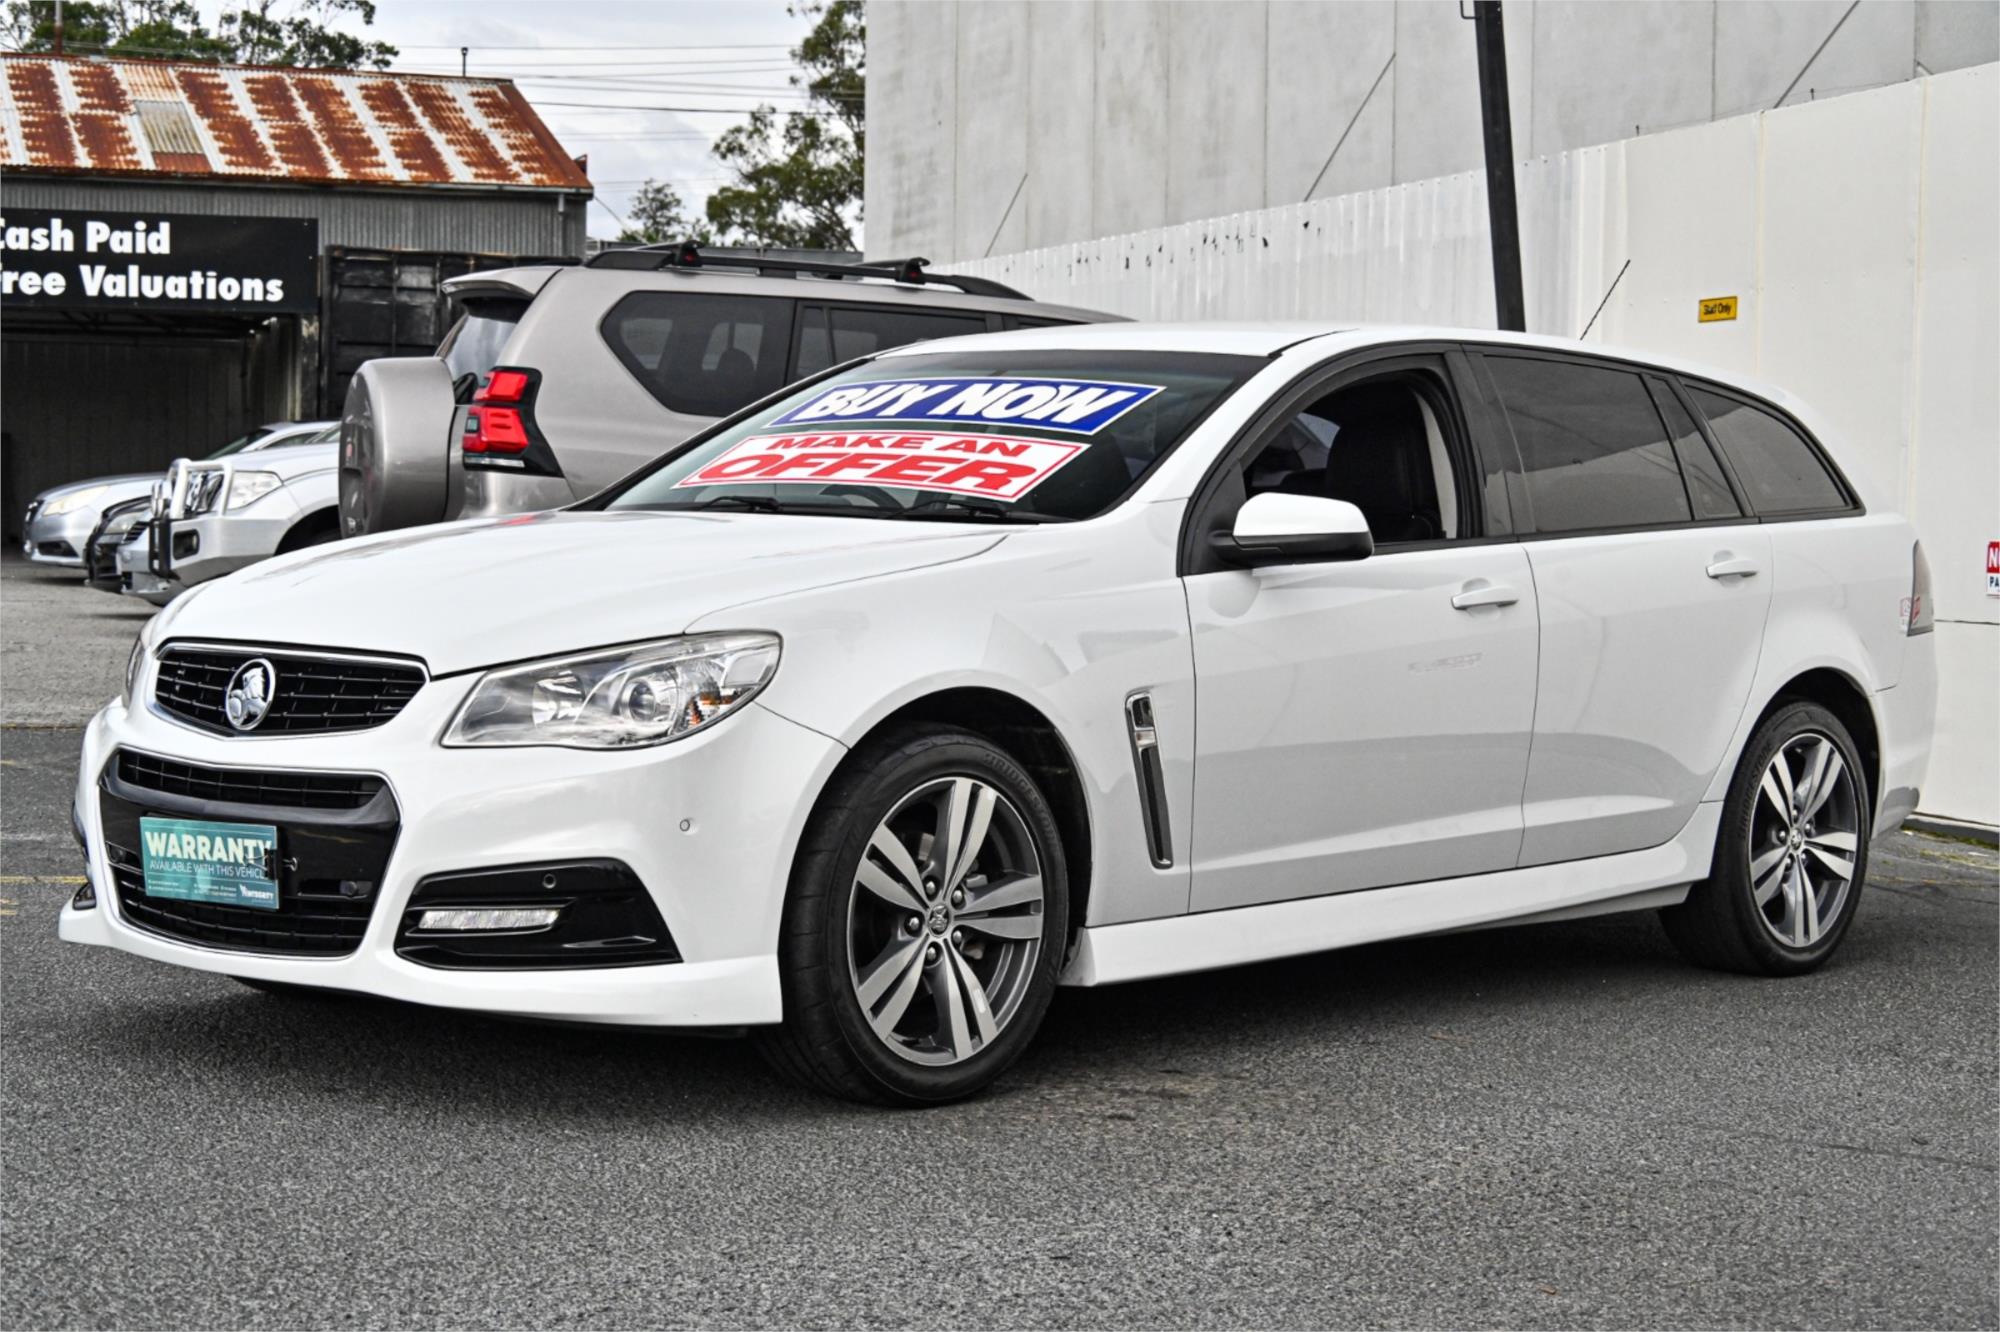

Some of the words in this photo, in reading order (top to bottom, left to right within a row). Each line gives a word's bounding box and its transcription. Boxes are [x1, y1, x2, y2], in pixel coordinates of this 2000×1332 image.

[0, 218, 74, 251] ash
[86, 221, 170, 254] Paid
[0, 263, 66, 295] ree
[79, 264, 284, 301] Valuations
[802, 383, 942, 418] BUY
[956, 383, 1131, 424] NOW
[766, 435, 925, 451] MAKE
[942, 439, 1032, 457] AN
[697, 453, 1039, 491] OFFER
[1988, 547, 2000, 568] N
[145, 832, 272, 865] WARRANTY
[150, 861, 192, 873] AVAILABLE
[194, 864, 214, 875] WITH
[215, 866, 234, 877] THIS
[234, 867, 269, 880] VEHICL
